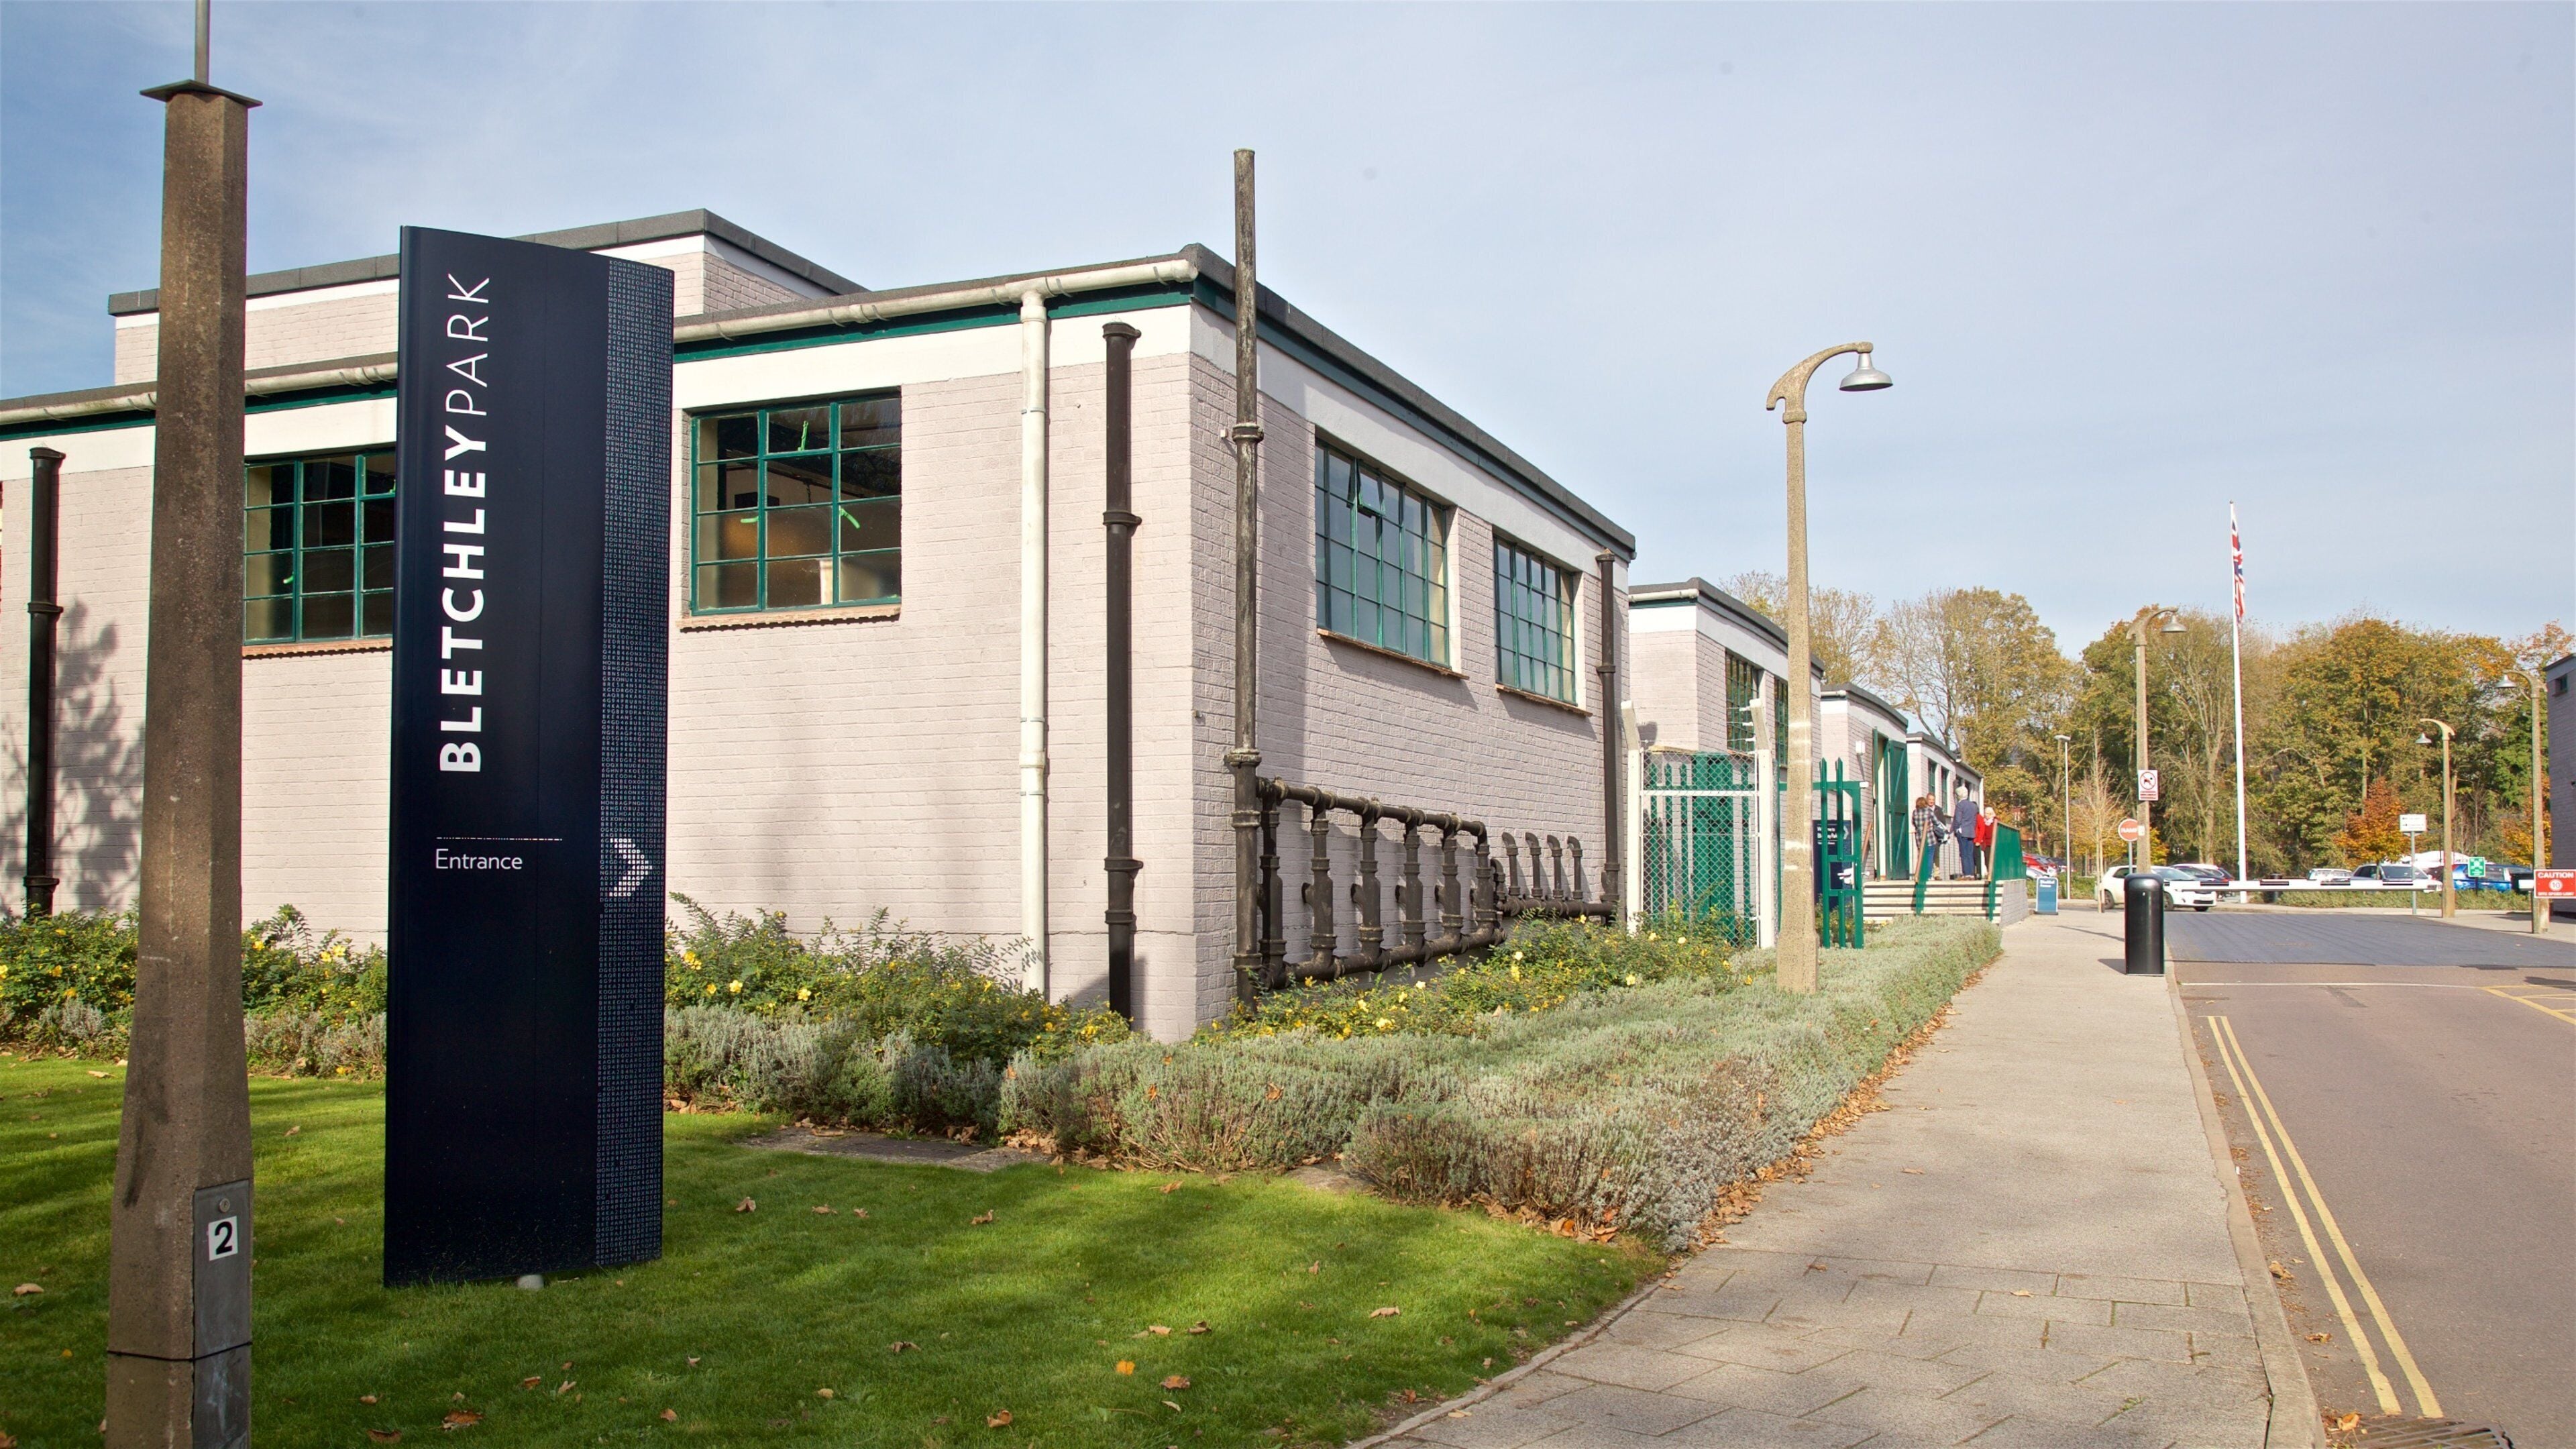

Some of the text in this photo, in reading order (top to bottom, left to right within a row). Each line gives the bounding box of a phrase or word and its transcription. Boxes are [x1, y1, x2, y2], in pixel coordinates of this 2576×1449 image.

[440, 274, 489, 771] BLETCHLEY PARK
[436, 849, 522, 869] Entrance
[215, 1222, 232, 1254] 2
